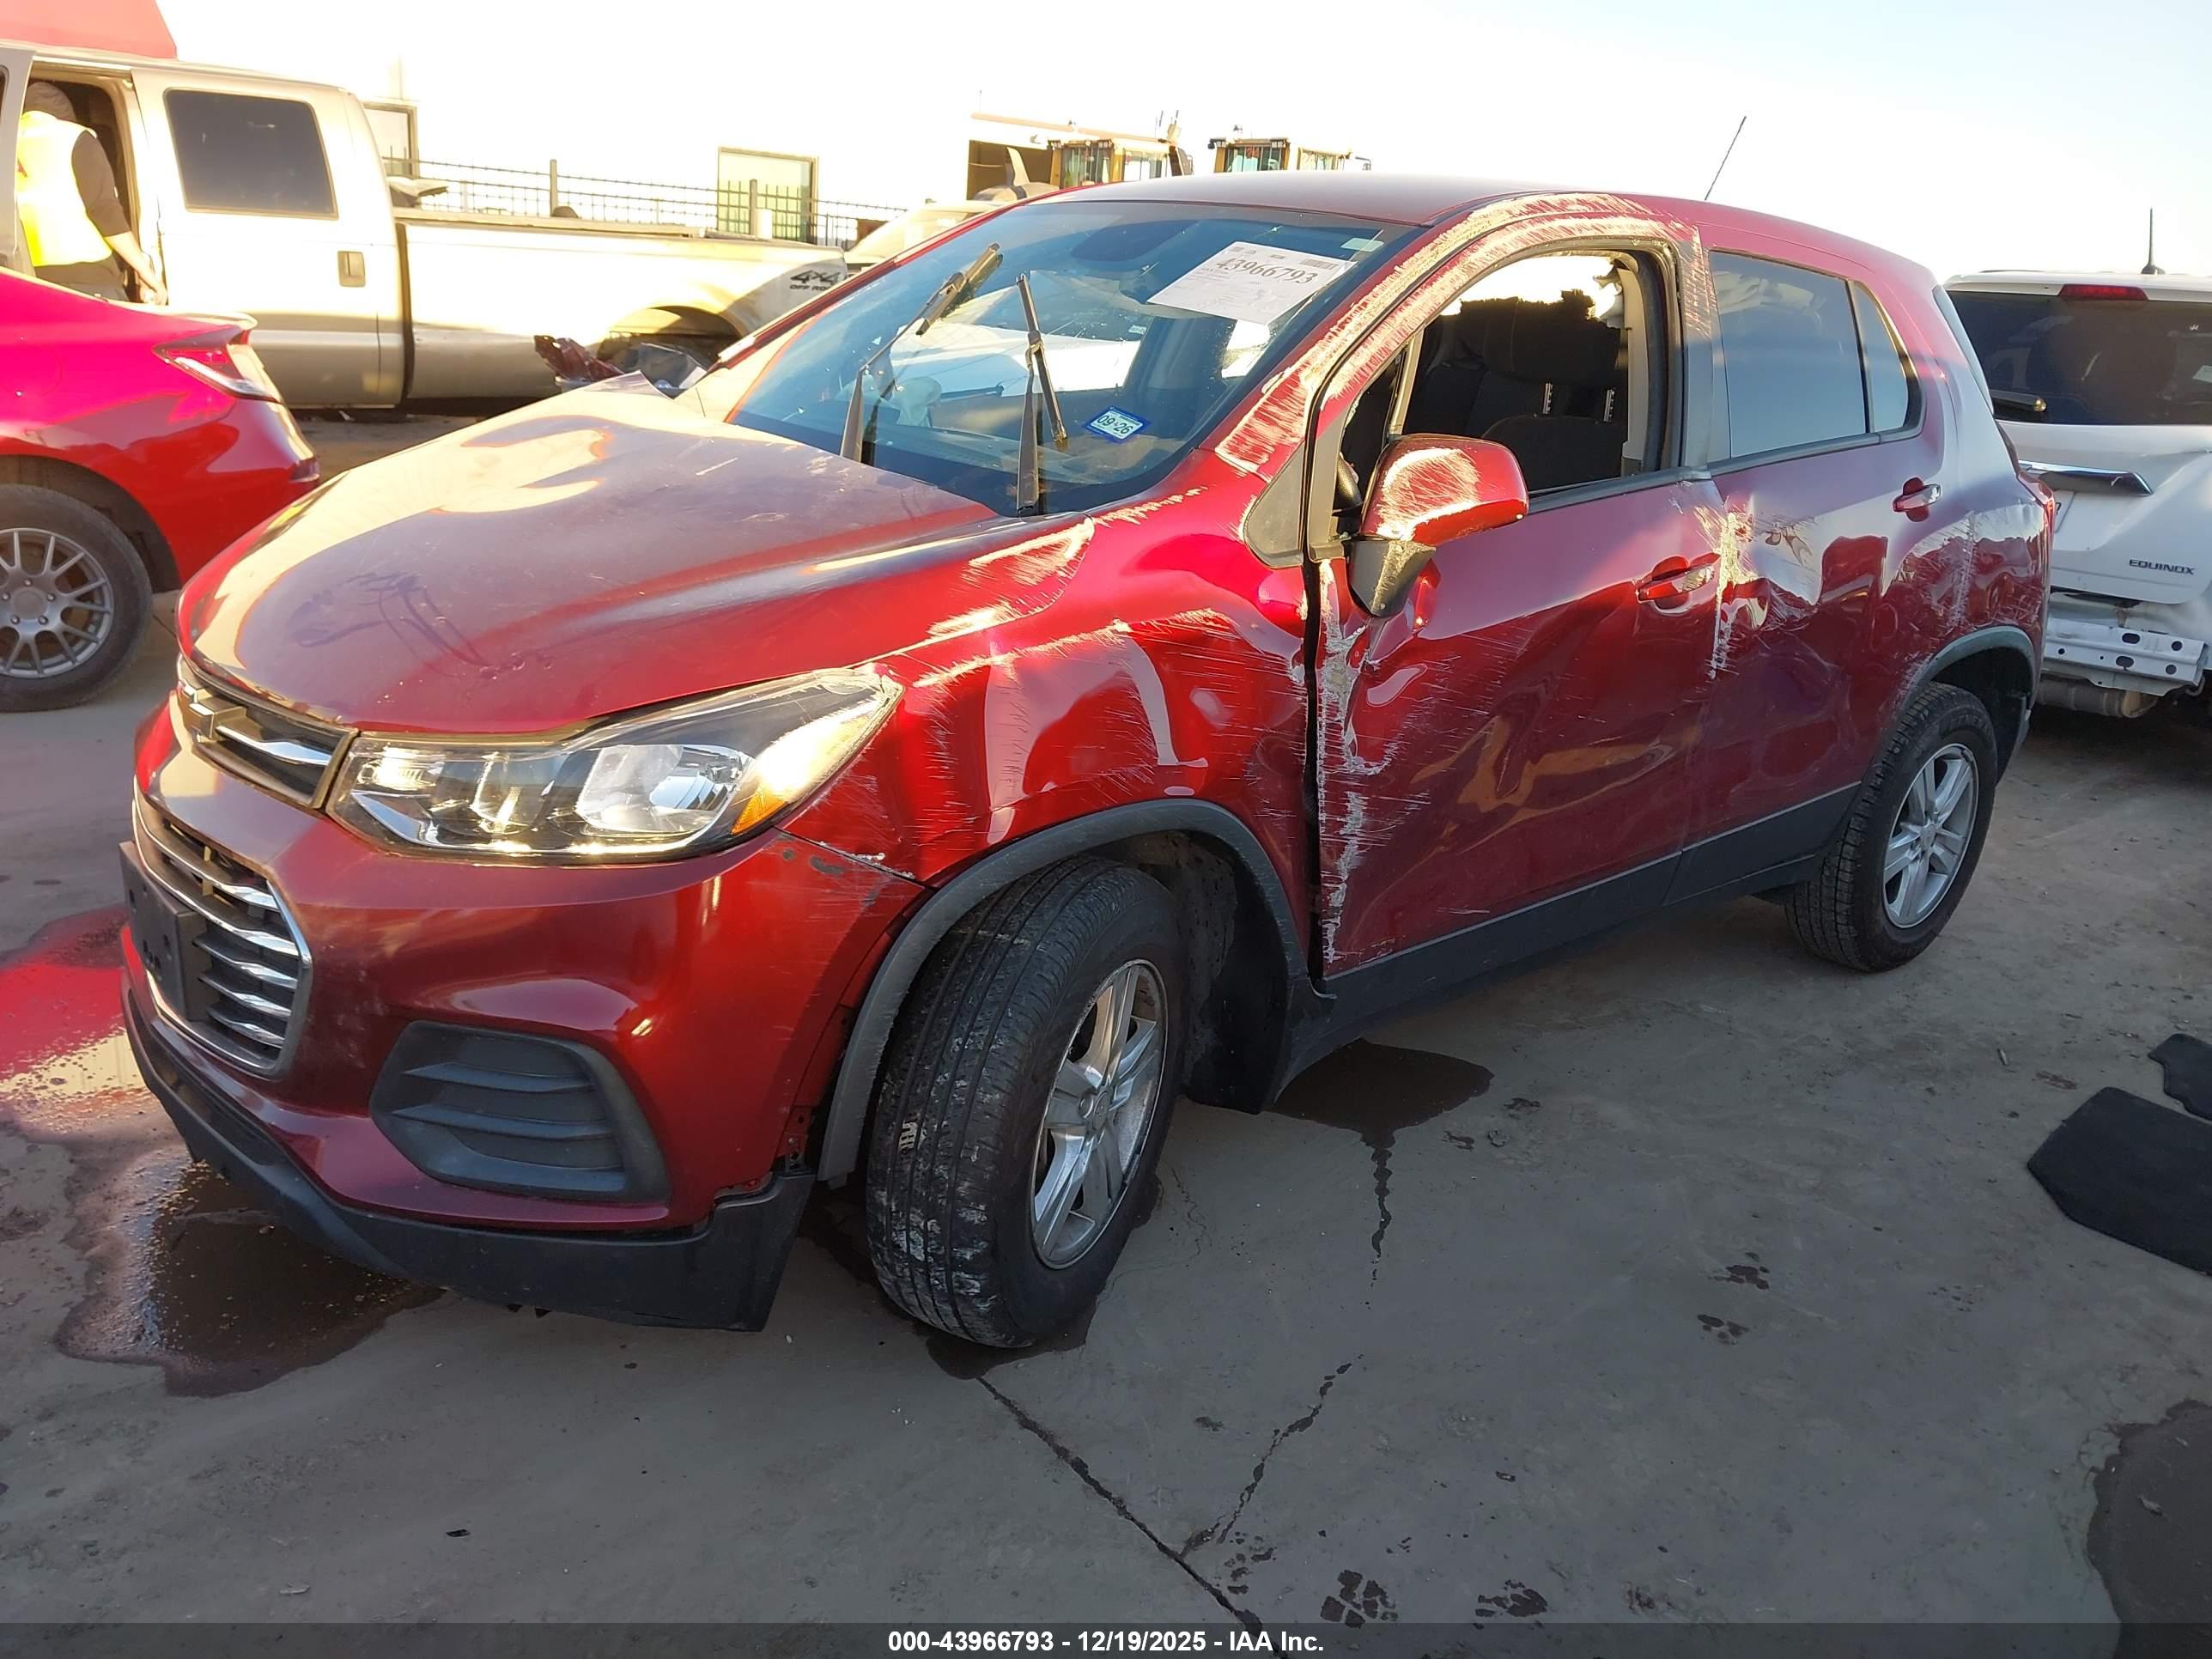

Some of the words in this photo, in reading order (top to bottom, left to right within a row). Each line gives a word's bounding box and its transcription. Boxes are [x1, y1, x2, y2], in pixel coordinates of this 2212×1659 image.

[1216, 255, 1319, 284] 43966793
[1097, 415, 1116, 427] 09
[1112, 422, 1133, 434] 26
[2129, 558, 2197, 575] EQUINOX
